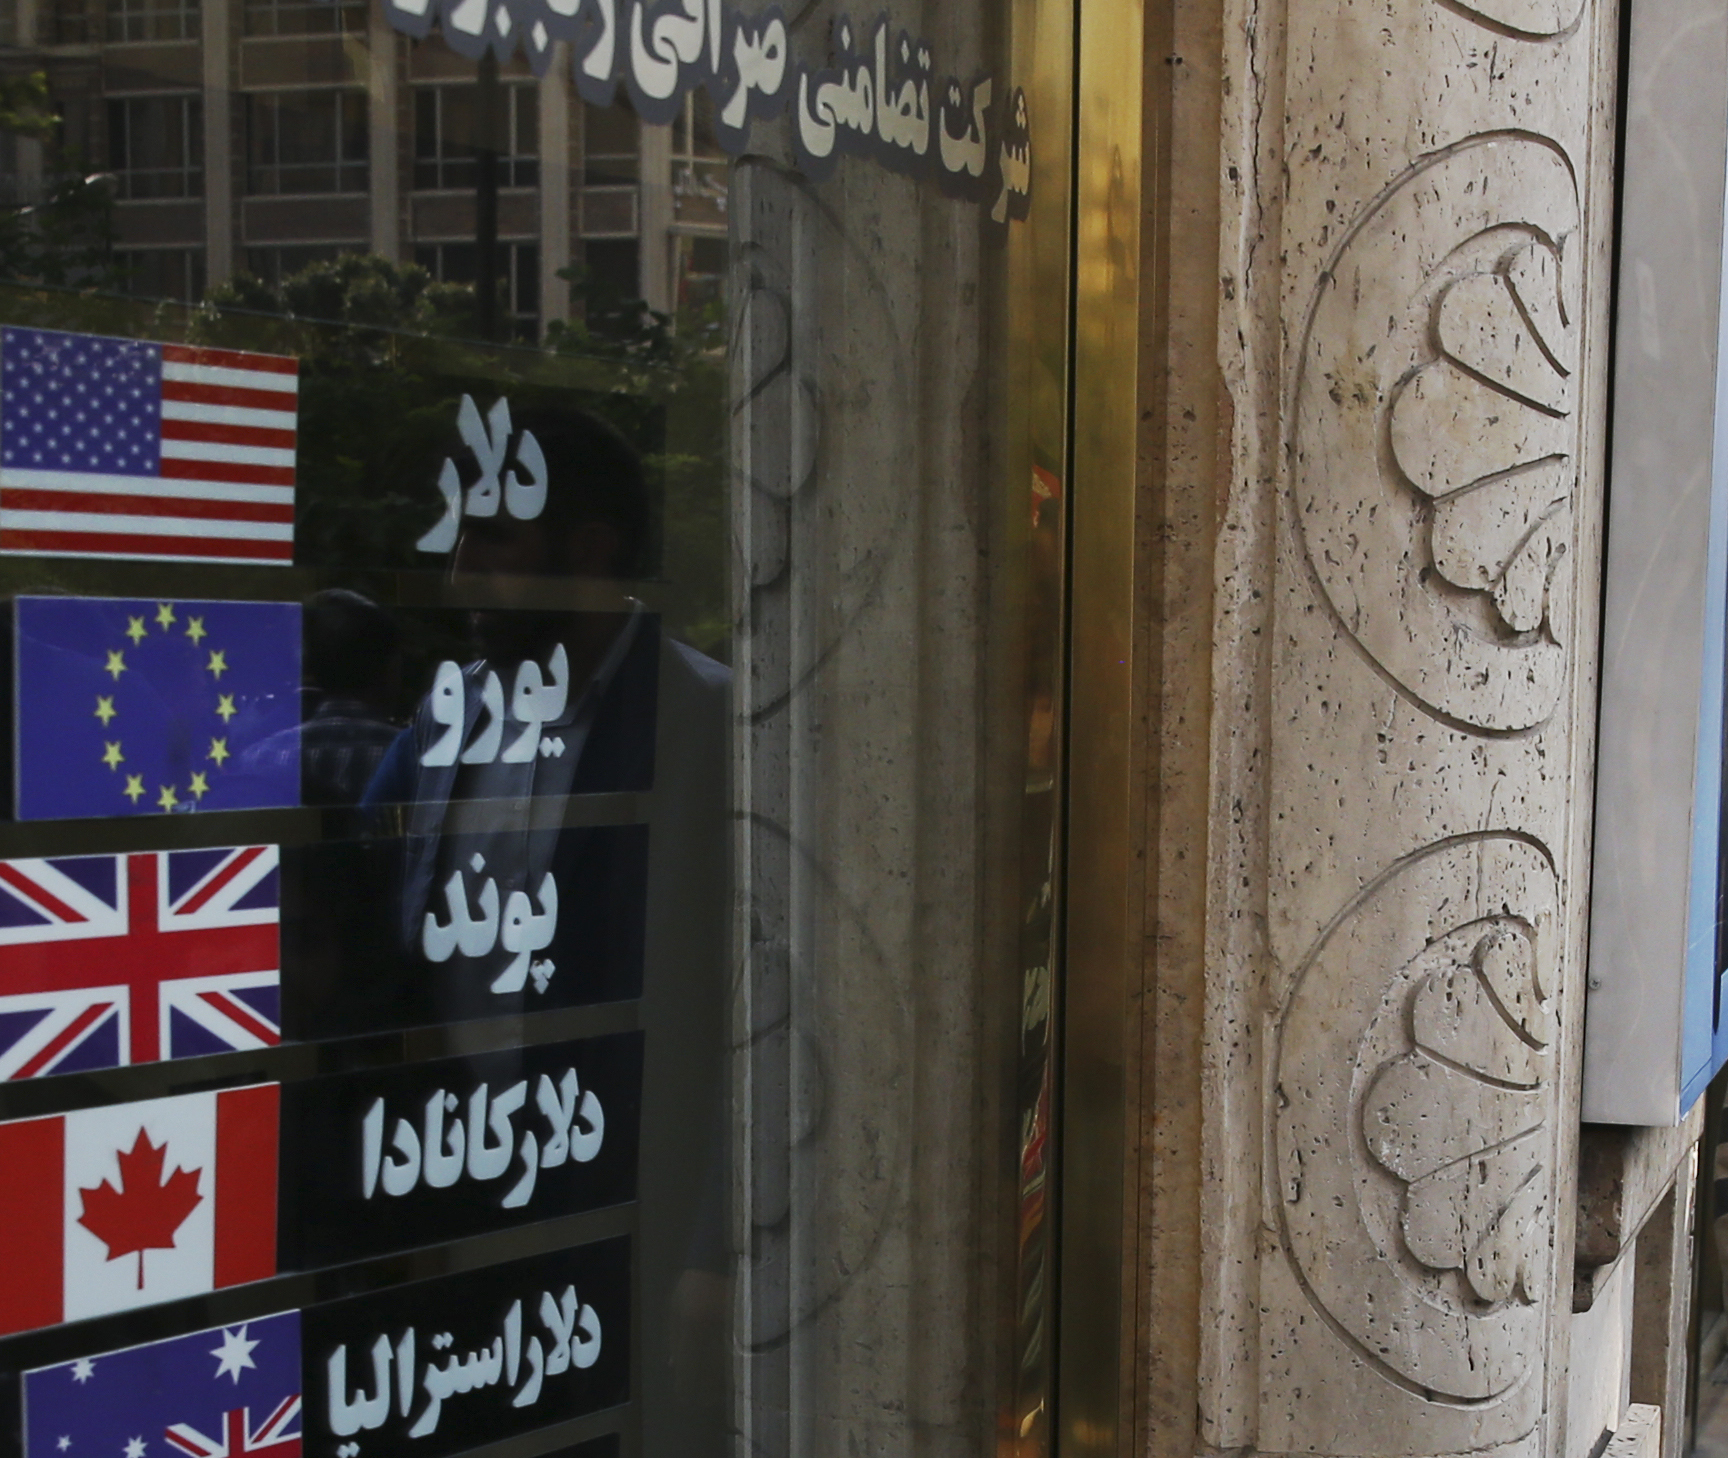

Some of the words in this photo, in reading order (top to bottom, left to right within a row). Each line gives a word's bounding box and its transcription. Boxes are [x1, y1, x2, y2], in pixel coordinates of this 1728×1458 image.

[797, 23, 931, 157] تضامنی
[939, 77, 1031, 224] شرکت
[415, 394, 548, 553] دلار
[420, 643, 569, 767] یورو
[422, 852, 559, 995] پوند
